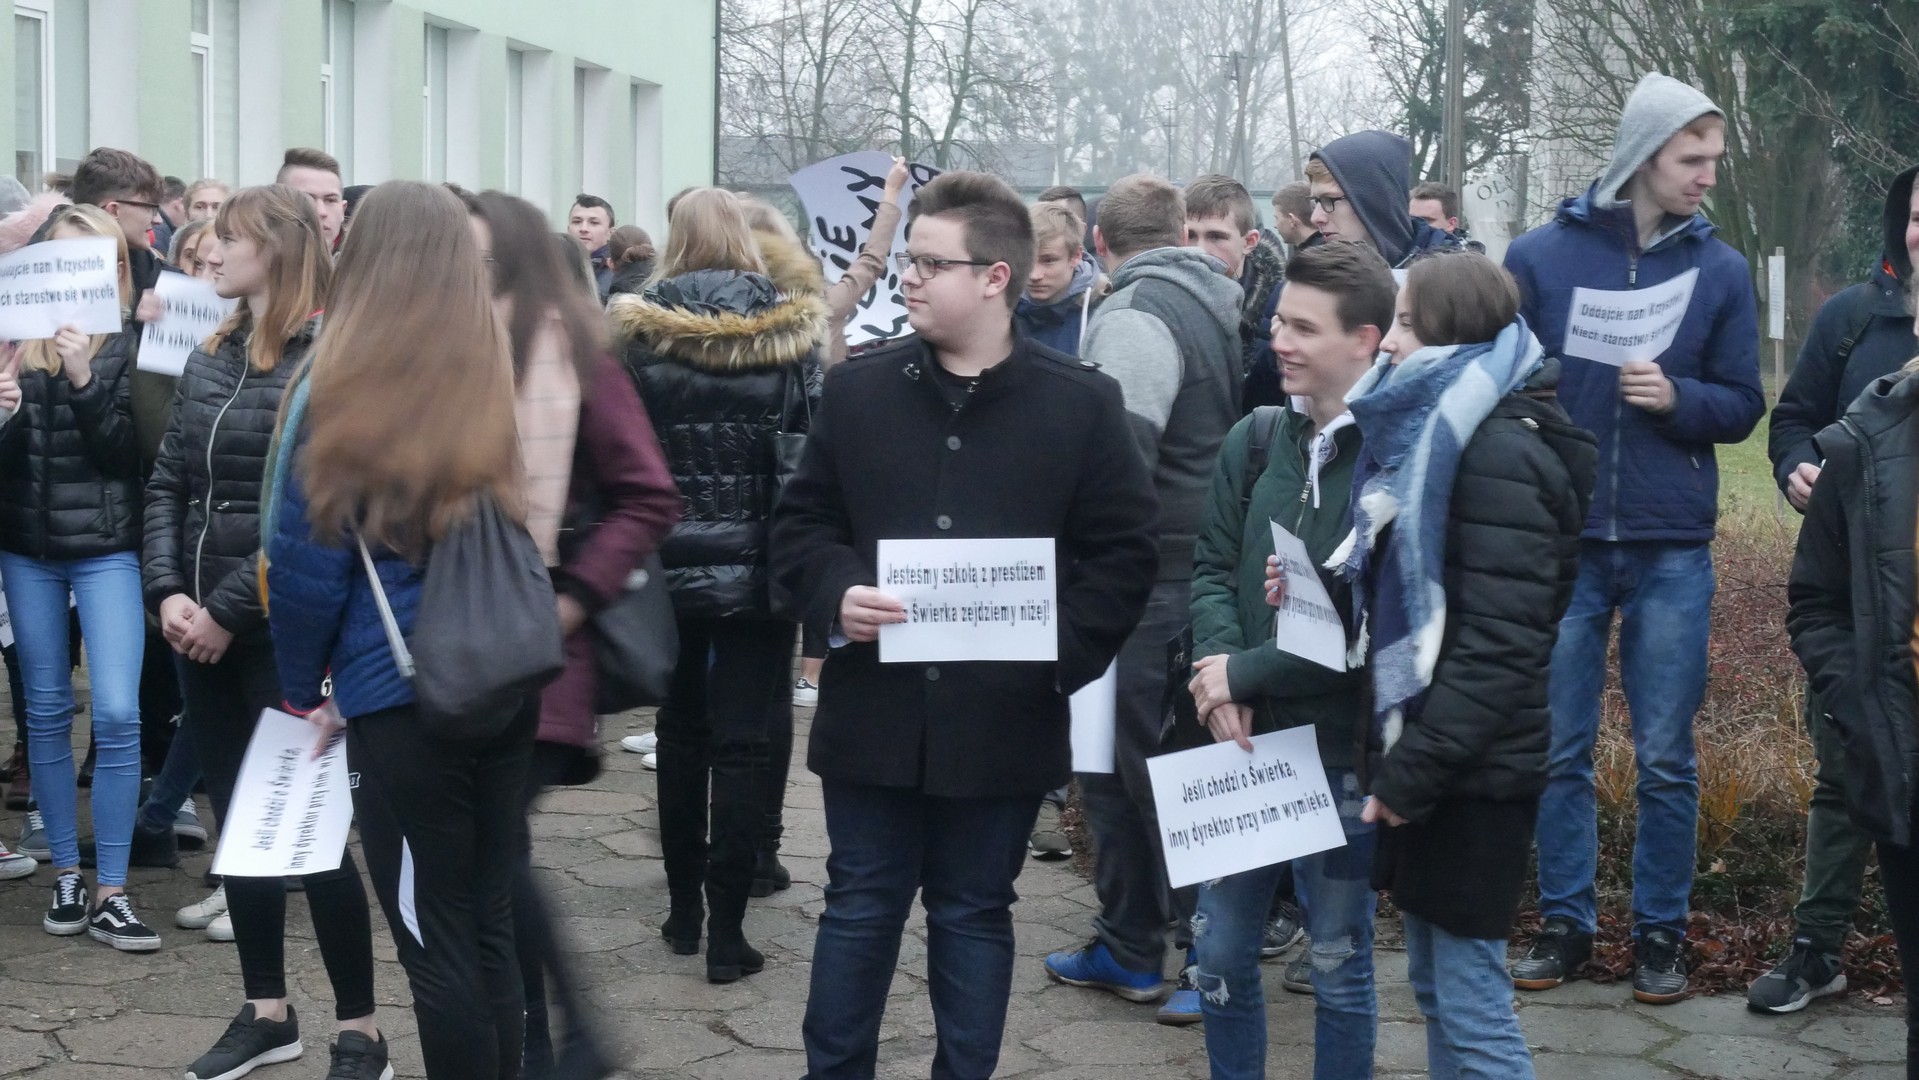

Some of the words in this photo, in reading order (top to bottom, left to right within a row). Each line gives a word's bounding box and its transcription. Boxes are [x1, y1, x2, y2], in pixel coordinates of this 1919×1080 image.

[34, 262, 52, 274] nam
[15, 289, 61, 304] starostwo
[65, 286, 77, 304] się
[1581, 304, 1625, 323] Oddajcie
[148, 322, 164, 344] Dla
[1572, 325, 1599, 341] Niech
[1602, 332, 1649, 347] starostwo
[887, 562, 938, 589] Jesteśmy
[943, 561, 978, 588] szkołą
[982, 567, 988, 583] z
[992, 560, 1046, 587] prestiżem
[912, 598, 958, 623] Świerka
[962, 601, 1016, 627] zejdziemy
[1020, 600, 1050, 627] niżej!
[310, 771, 331, 789] nim
[1182, 779, 1206, 804] Jeśli
[1207, 770, 1240, 797] chodzi
[1242, 773, 1248, 788] o
[1249, 759, 1298, 786] Świerka,
[308, 789, 331, 809] przy
[257, 797, 289, 828] chodzi
[1168, 828, 1190, 850] inny
[1192, 816, 1235, 846] dyrektor
[1236, 810, 1259, 836] przy
[1260, 803, 1281, 824] nim
[1282, 790, 1330, 821] wymięka
[252, 828, 278, 851] Jeśli
[290, 811, 320, 848] dyrektor
[284, 849, 313, 869] inny
